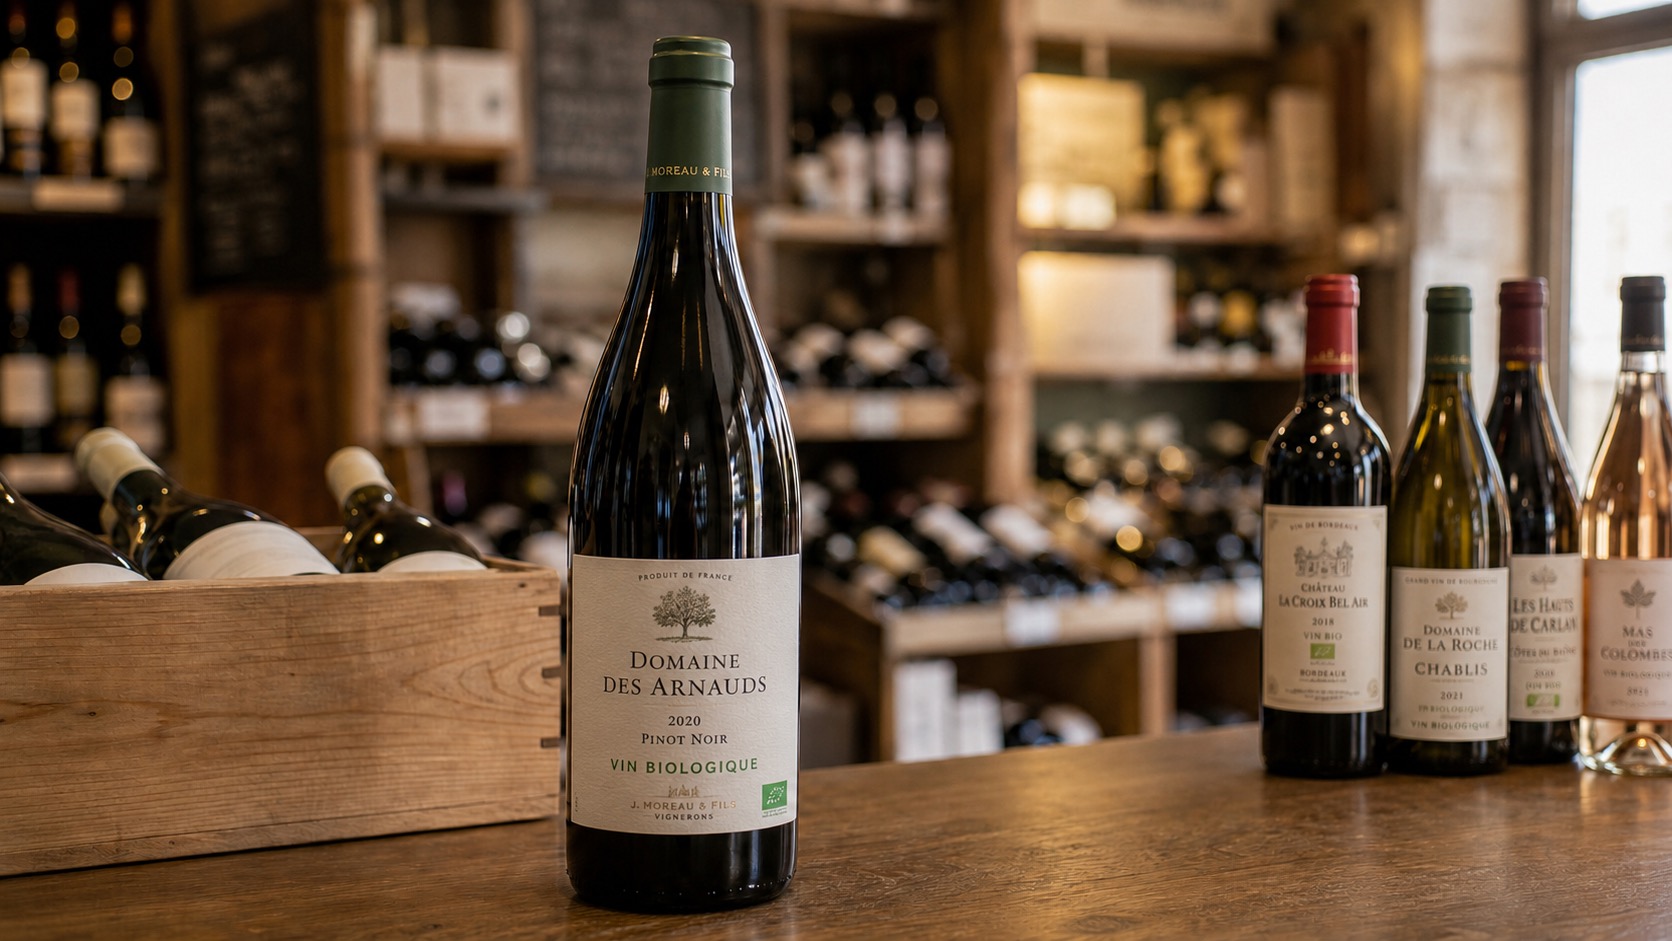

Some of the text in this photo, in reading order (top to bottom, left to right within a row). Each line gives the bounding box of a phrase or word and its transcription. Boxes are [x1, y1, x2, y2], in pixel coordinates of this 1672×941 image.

[651, 166, 698, 176] MOREAU
[702, 166, 711, 177] &
[638, 572, 678, 581] PRODUIT
[698, 572, 733, 581] FRANCE
[1301, 582, 1346, 593] CHÂTEAU
[1279, 595, 1369, 608] LA CROIX BEL AIR
[1513, 597, 1535, 614] LES
[1312, 617, 1334, 626] 2018
[1510, 617, 1527, 633] DE
[1303, 631, 1342, 641] VIN BIO
[1423, 625, 1480, 636] DOMAINE
[1622, 625, 1653, 639] MAS
[1403, 638, 1498, 652] DE LA ROCHE
[630, 650, 740, 670] DOMAINE
[1414, 662, 1488, 676] CHABLIS
[603, 676, 767, 696] DES ARNAUDS
[1440, 691, 1463, 700] 2021
[668, 716, 701, 726] 2020
[641, 733, 728, 745] PINOT NOIR
[611, 758, 758, 774] VIN BIOLOGIQUE
[630, 801, 737, 811] J. MOREAU & FILS
[654, 813, 714, 821] VIGNERONS
